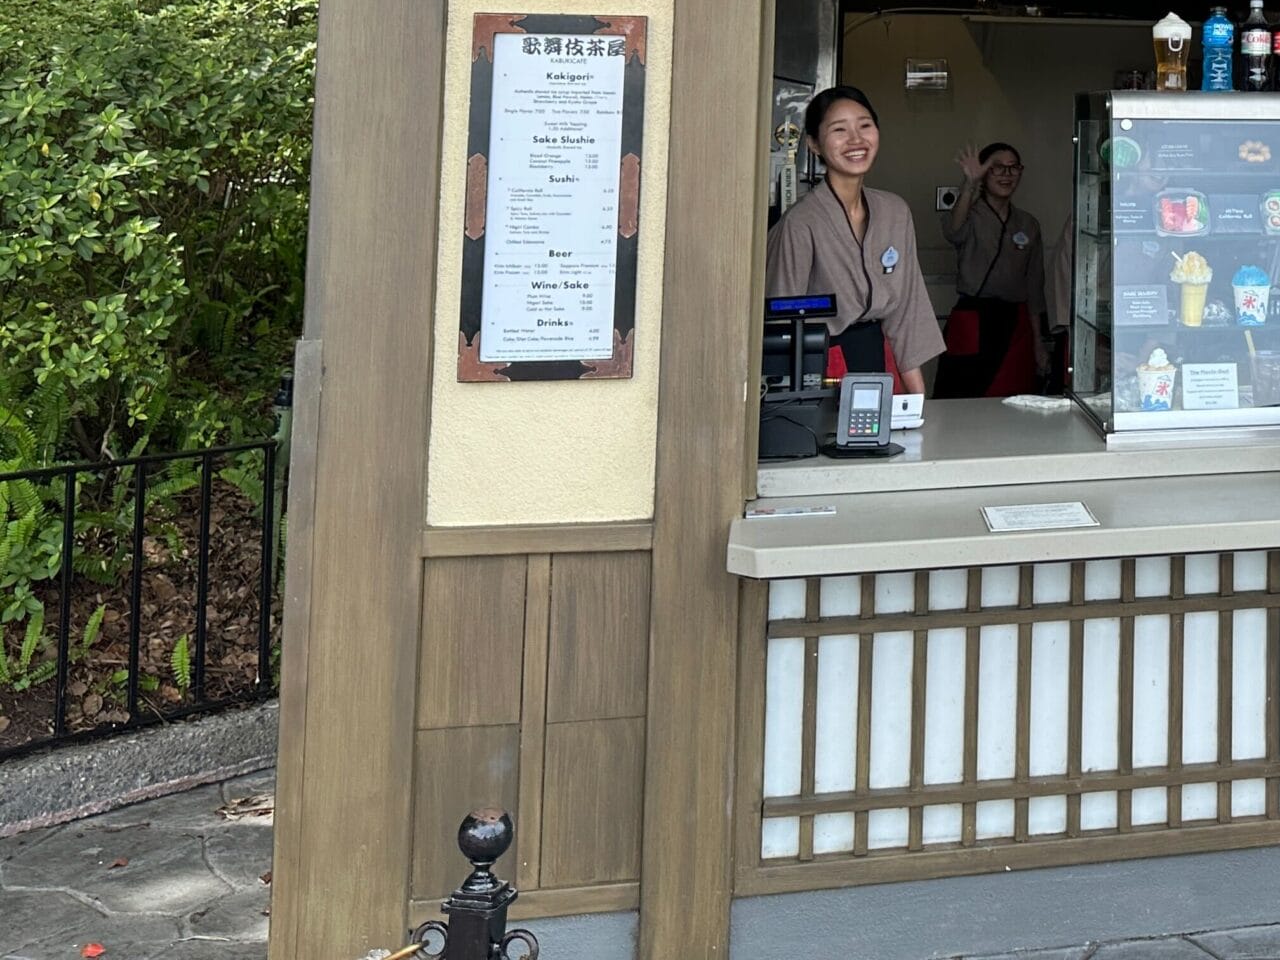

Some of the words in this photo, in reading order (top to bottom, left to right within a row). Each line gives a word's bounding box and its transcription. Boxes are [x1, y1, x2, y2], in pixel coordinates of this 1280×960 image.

[522, 37, 626, 57] 歌舞伎茶屋
[546, 72, 590, 83] Kakigori
[533, 135, 557, 144] Sake
[561, 135, 596, 144] Slushie
[549, 175, 575, 183] Sushi
[549, 250, 573, 258] Beer
[531, 281, 589, 290] Wine/Sake
[537, 318, 569, 327] Drinks
